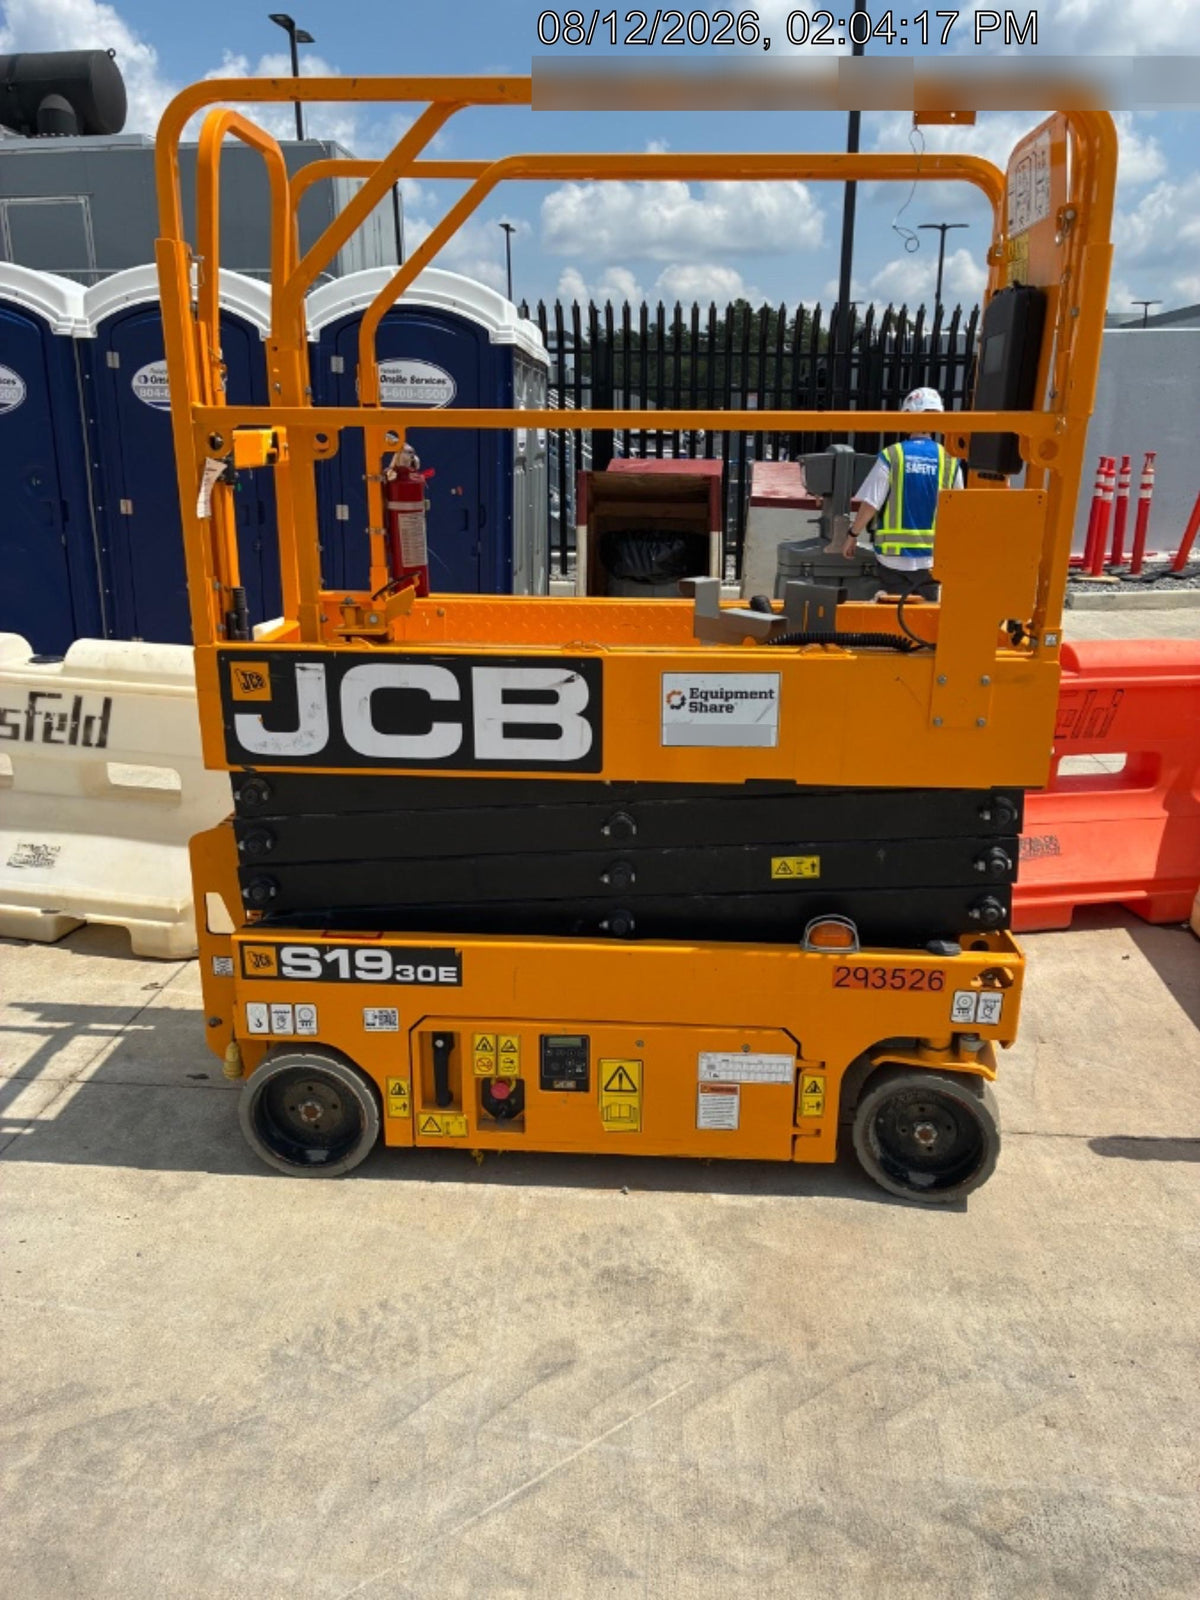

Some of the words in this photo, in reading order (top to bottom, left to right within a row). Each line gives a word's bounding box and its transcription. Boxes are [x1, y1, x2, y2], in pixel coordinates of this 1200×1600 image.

[905, 462, 938, 475] SAFETY
[241, 671, 266, 693] JCB
[689, 687, 775, 702] Equipment
[234, 662, 593, 761] JCB
[689, 701, 735, 714] Share
[834, 966, 945, 991] 293526
